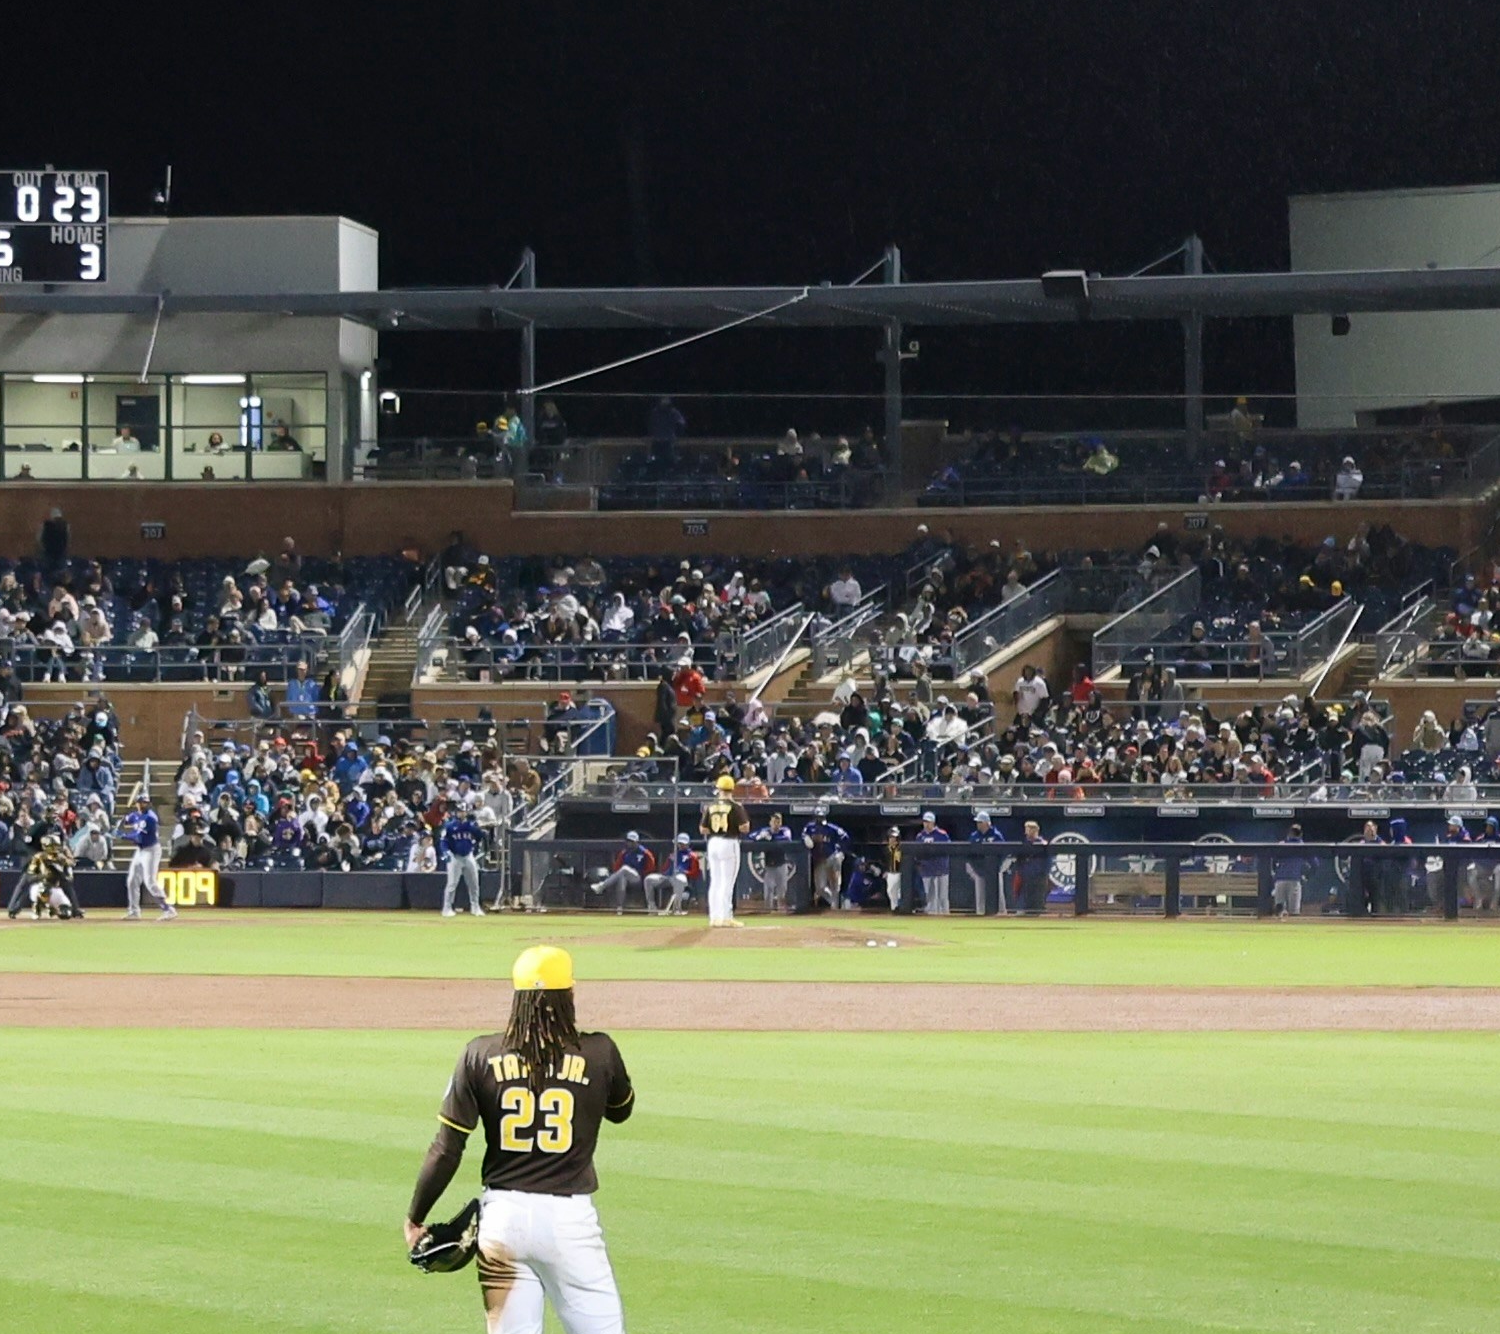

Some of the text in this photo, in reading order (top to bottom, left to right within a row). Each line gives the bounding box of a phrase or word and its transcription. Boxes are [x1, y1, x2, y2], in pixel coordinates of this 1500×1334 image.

[13, 172, 45, 188] OUT
[75, 173, 99, 188] BAT
[16, 186, 40, 223] 0
[52, 186, 100, 223] 23
[51, 226, 103, 245] HOME
[79, 243, 100, 280] 3
[556, 1053, 590, 1086] JR.
[500, 1086, 575, 1154] 23
